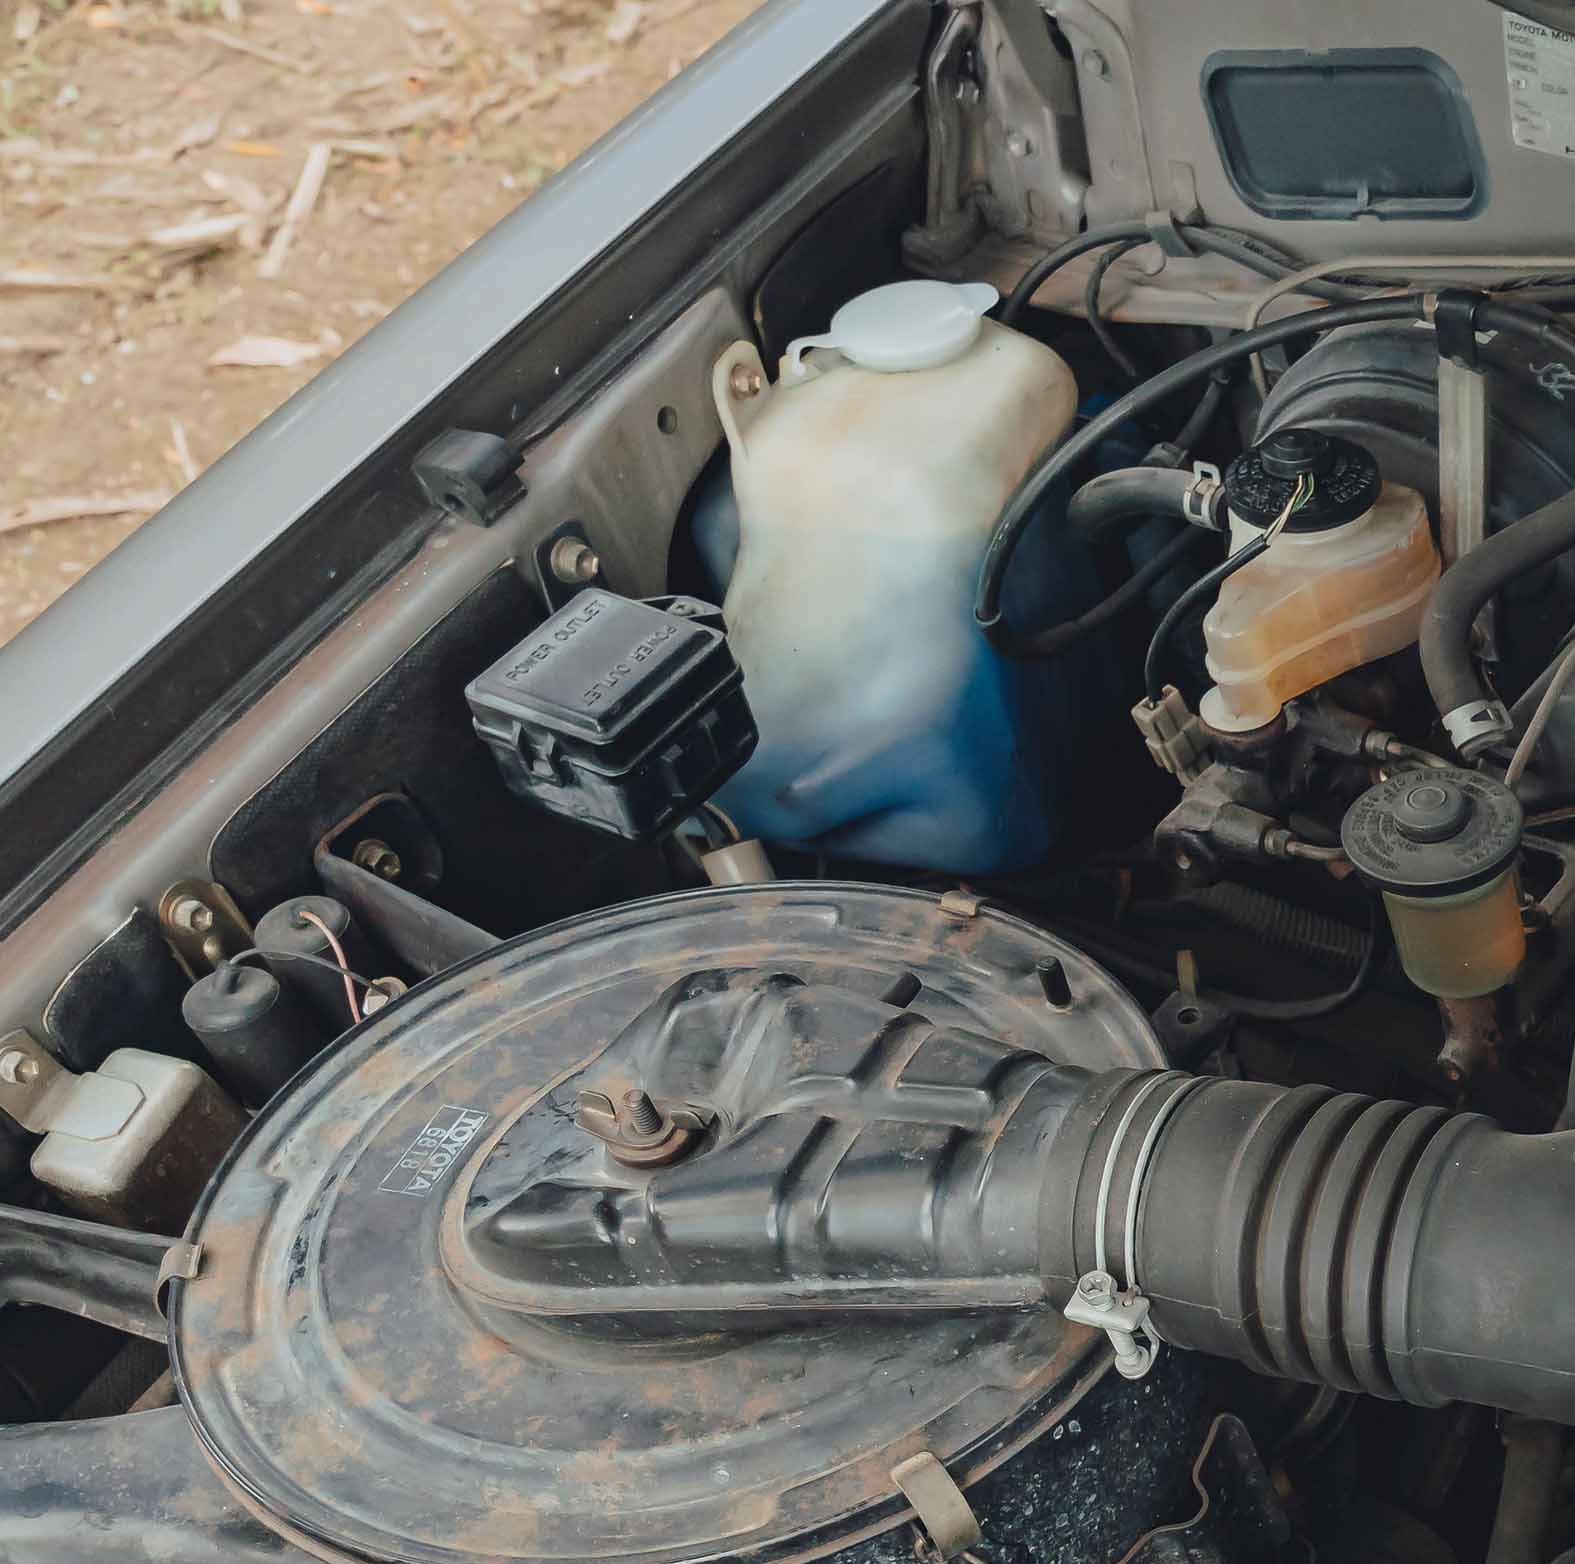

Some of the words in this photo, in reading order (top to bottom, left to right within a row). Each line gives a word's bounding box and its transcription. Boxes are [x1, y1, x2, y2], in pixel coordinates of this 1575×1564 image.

[1508, 20, 1548, 37] TOYOTA
[505, 642, 552, 682] POWER
[554, 599, 606, 641] OUTLET
[632, 623, 678, 662] POWER
[581, 663, 632, 707] OUTLET
[400, 1127, 447, 1169] 6818
[407, 1115, 484, 1191] TOYOTA
